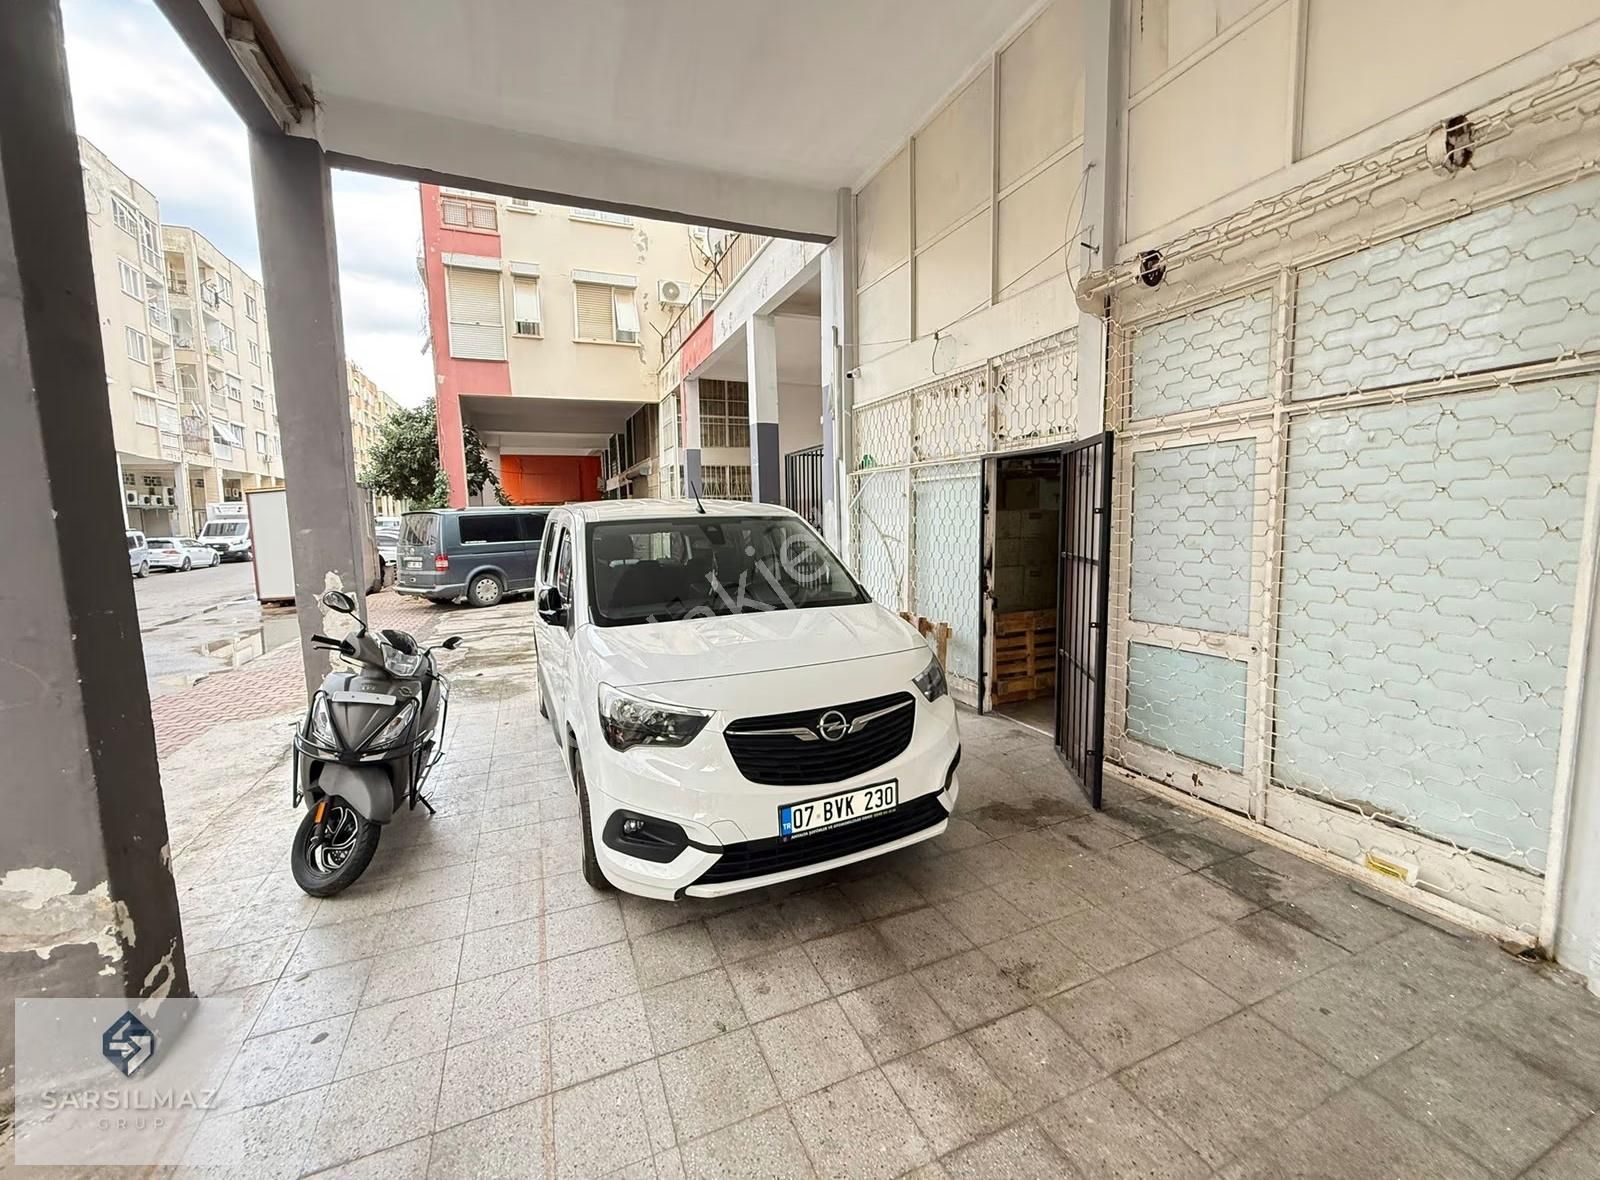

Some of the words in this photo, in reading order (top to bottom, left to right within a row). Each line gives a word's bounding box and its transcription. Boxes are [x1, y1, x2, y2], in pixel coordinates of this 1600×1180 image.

[793, 806, 814, 829] 07
[823, 795, 854, 822] BVK
[864, 786, 893, 812] 230
[783, 822, 791, 831] TR
